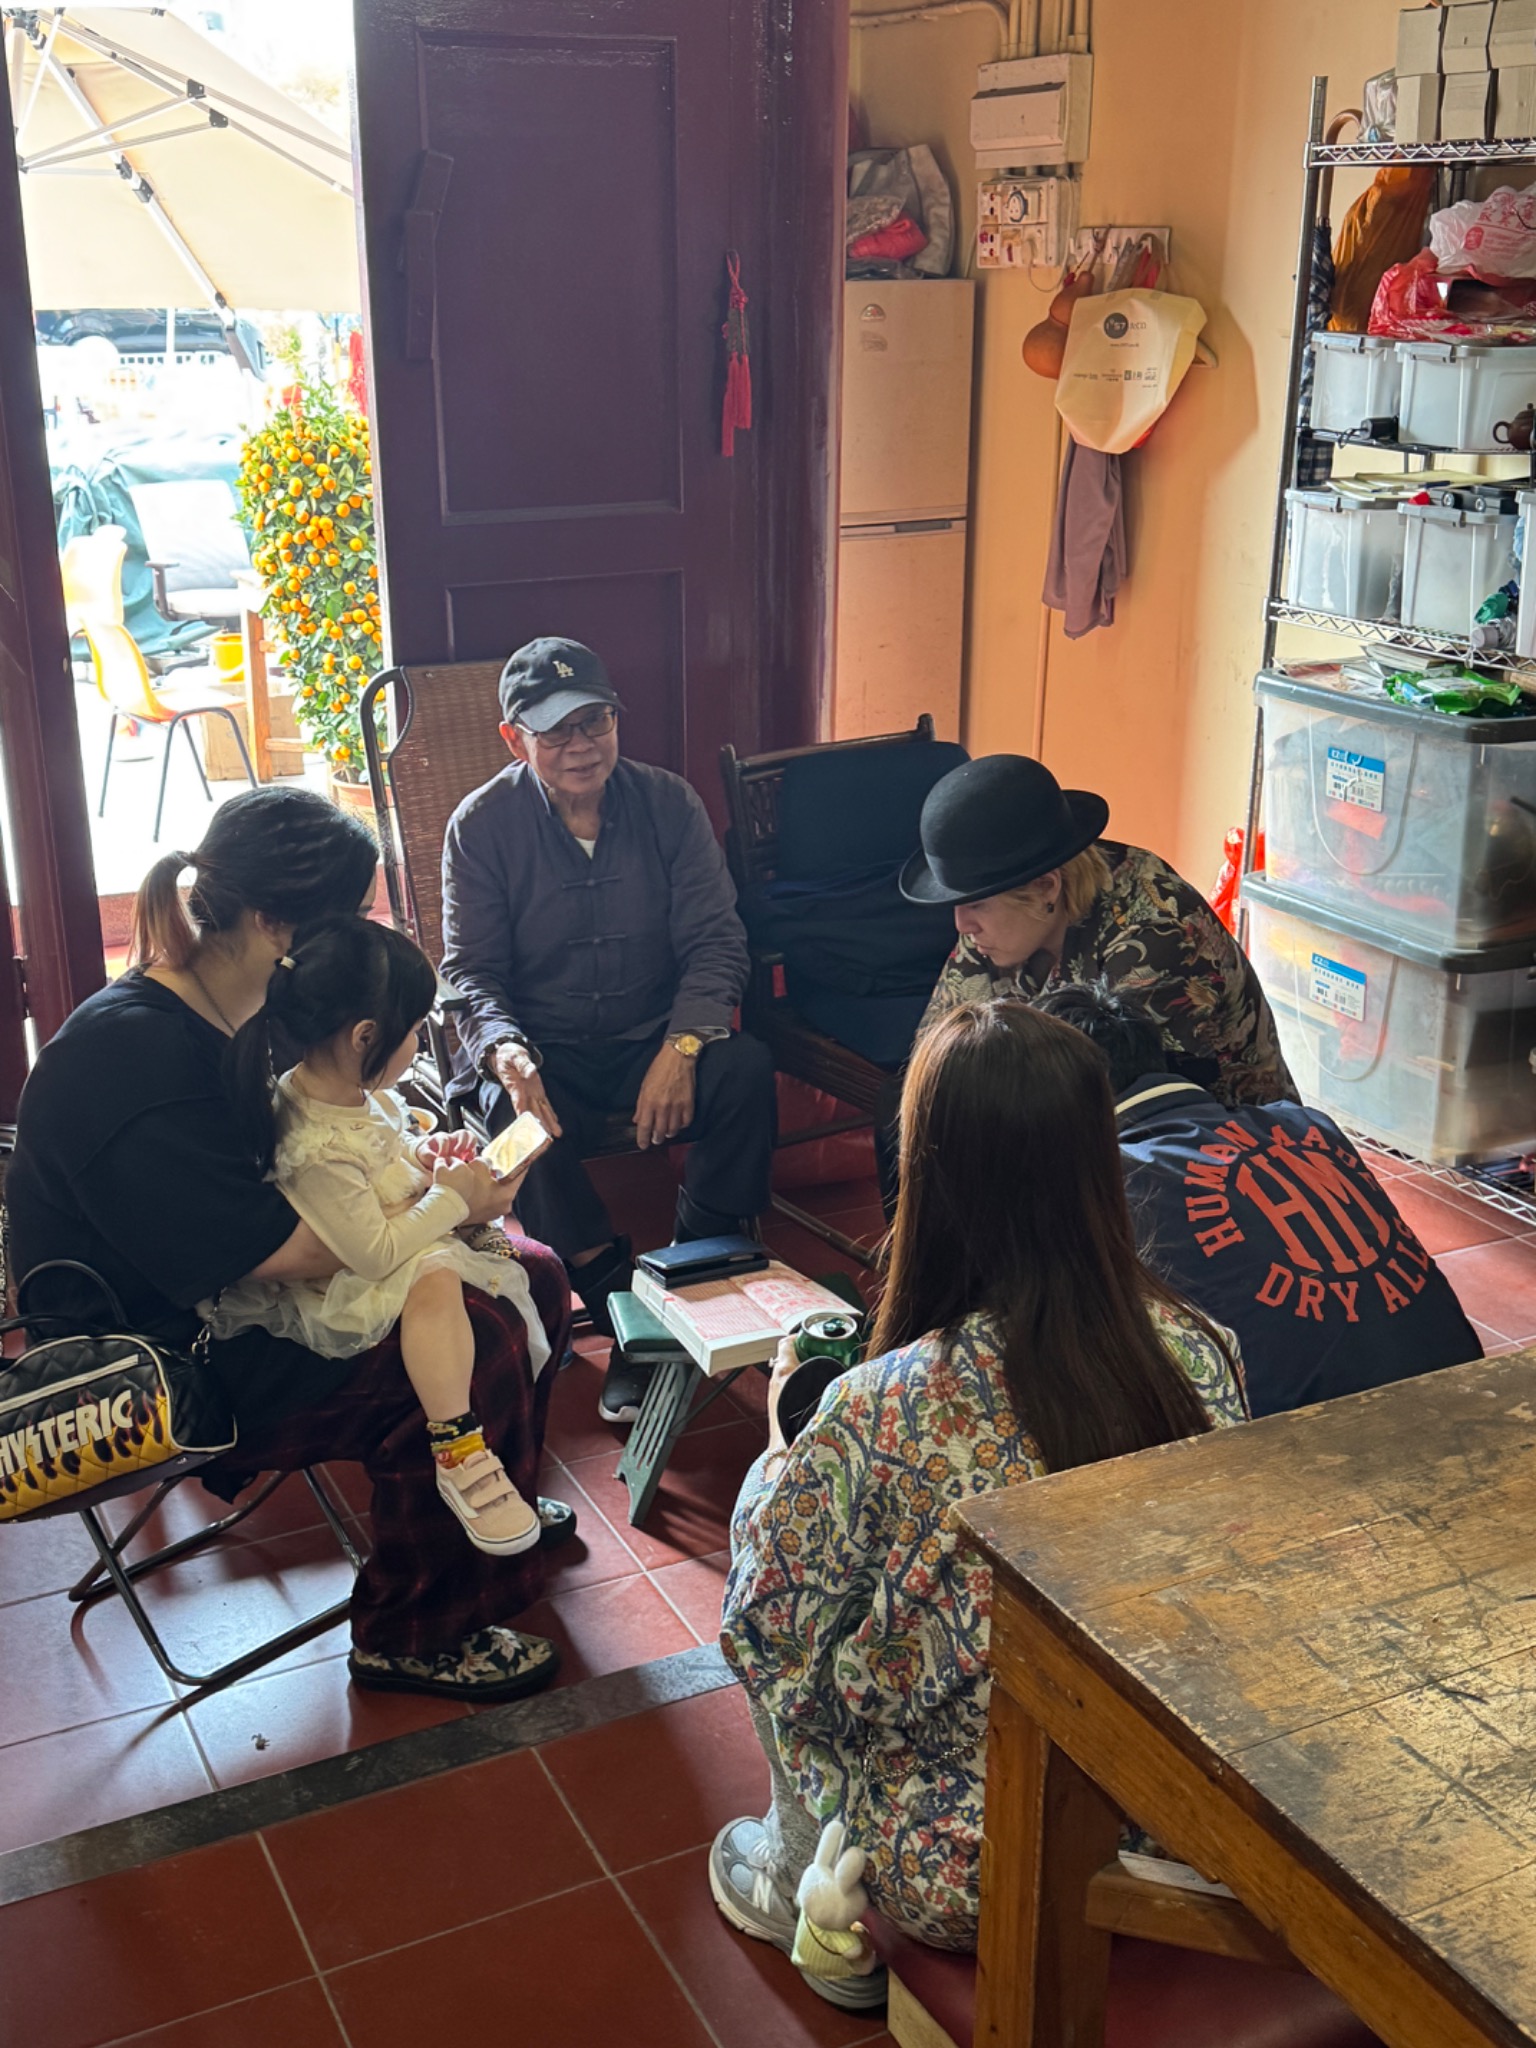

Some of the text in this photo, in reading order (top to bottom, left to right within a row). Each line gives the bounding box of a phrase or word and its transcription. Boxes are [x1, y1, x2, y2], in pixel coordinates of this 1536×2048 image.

[552, 660, 574, 678] LA
[1184, 1120, 1259, 1258] HUMAN
[1255, 1262, 1360, 1322] DRY
